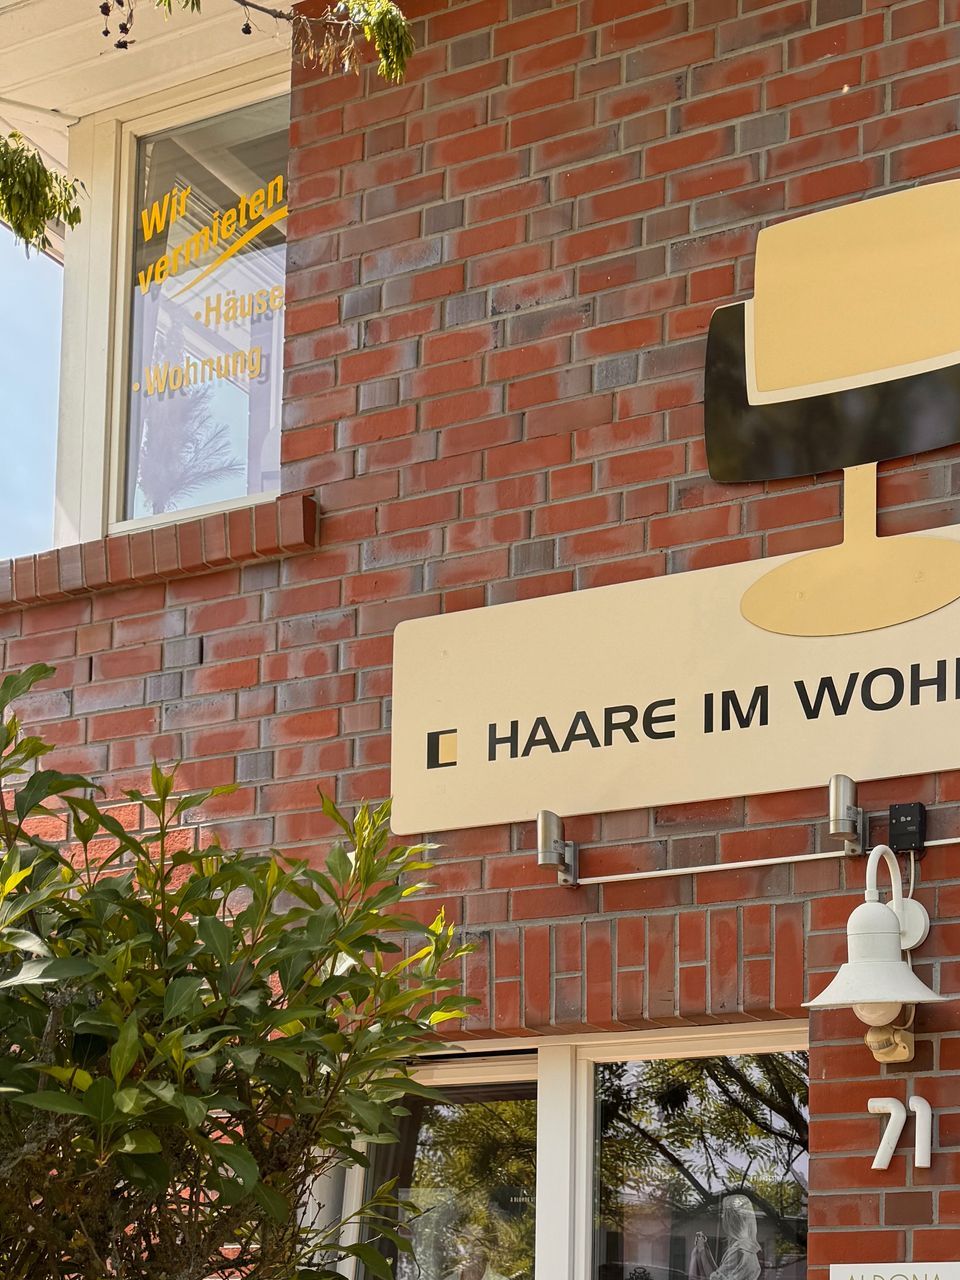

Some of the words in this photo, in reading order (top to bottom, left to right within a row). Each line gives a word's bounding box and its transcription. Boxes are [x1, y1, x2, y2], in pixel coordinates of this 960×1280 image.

[138, 174, 284, 296] vermieten
[140, 185, 192, 242] Wir
[144, 344, 263, 397] Wohnung
[488, 698, 676, 762] HAARE
[703, 684, 769, 734] IM
[867, 1095, 933, 1170] 71
